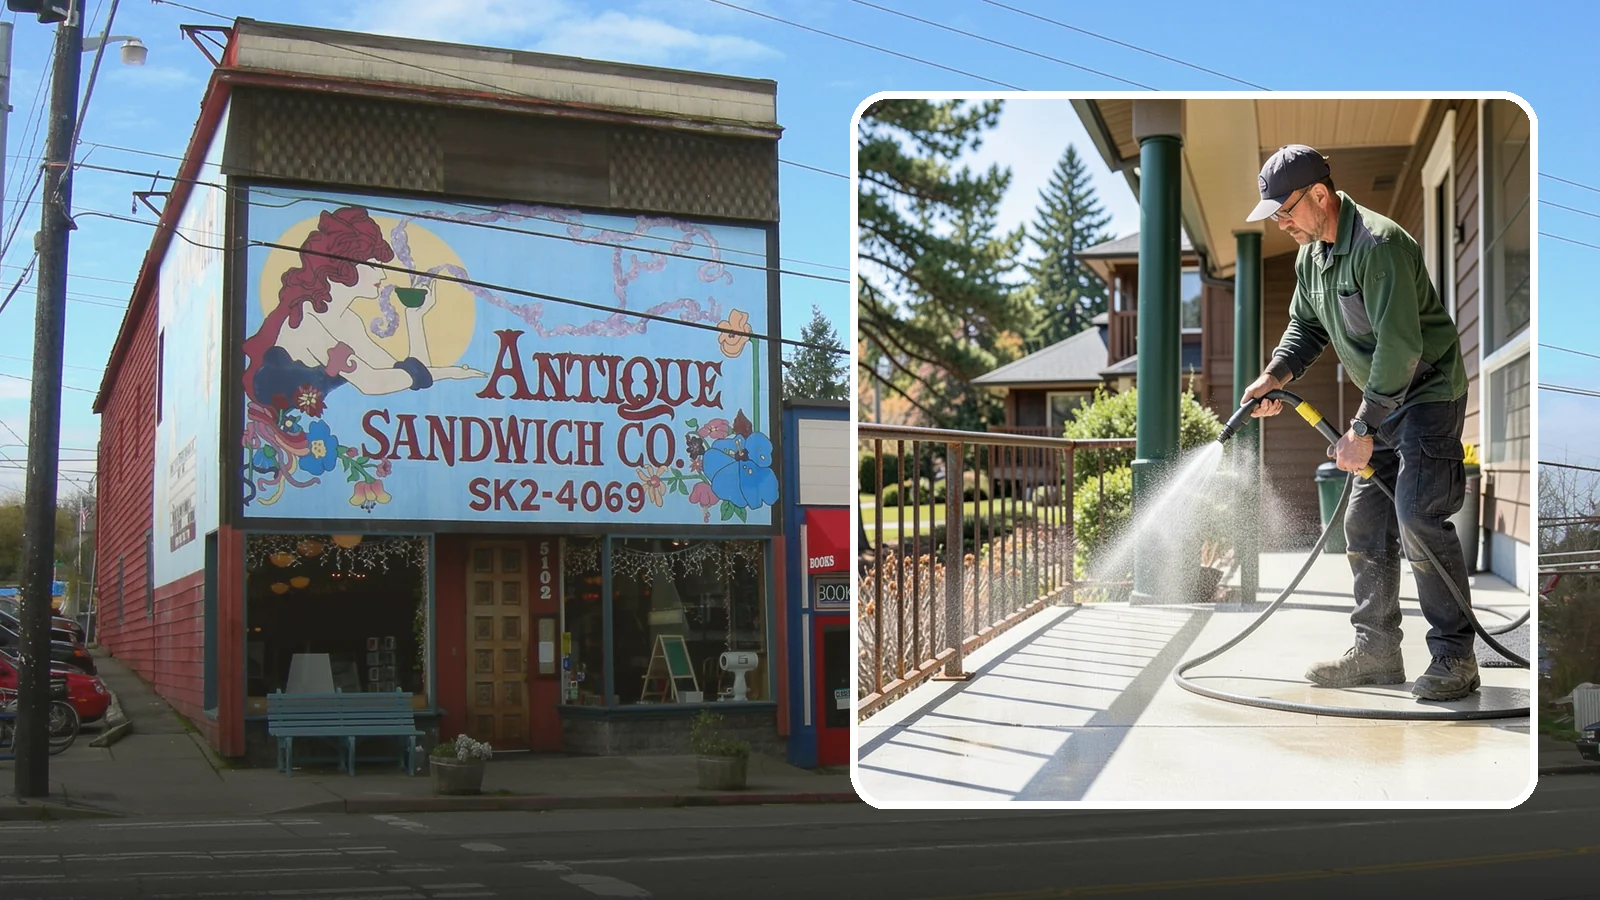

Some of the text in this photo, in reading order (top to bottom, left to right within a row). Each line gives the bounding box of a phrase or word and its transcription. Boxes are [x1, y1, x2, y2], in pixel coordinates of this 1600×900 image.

[476, 329, 723, 421] ANTIQUE
[361, 408, 685, 469] SANDWICH CO.
[468, 477, 646, 513] SK2-4069
[540, 541, 551, 600] 5102
[809, 555, 835, 569] BOOKS
